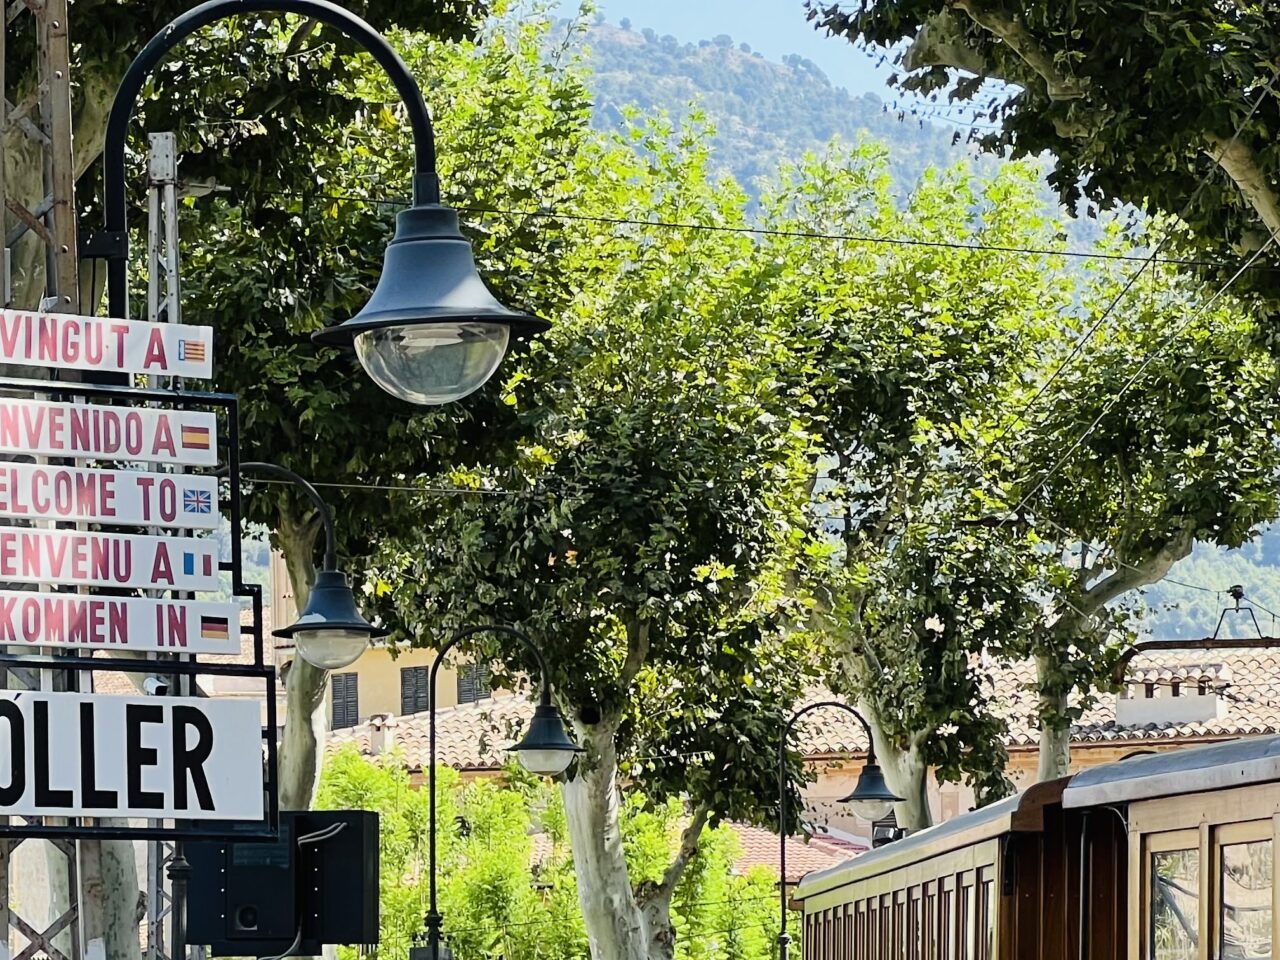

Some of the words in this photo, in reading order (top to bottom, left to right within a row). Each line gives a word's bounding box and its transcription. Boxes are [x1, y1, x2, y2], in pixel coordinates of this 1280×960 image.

[143, 327, 168, 370] A
[152, 414, 177, 457] A
[137, 477, 177, 523] TO
[151, 541, 175, 585] A
[156, 604, 188, 647] IN
